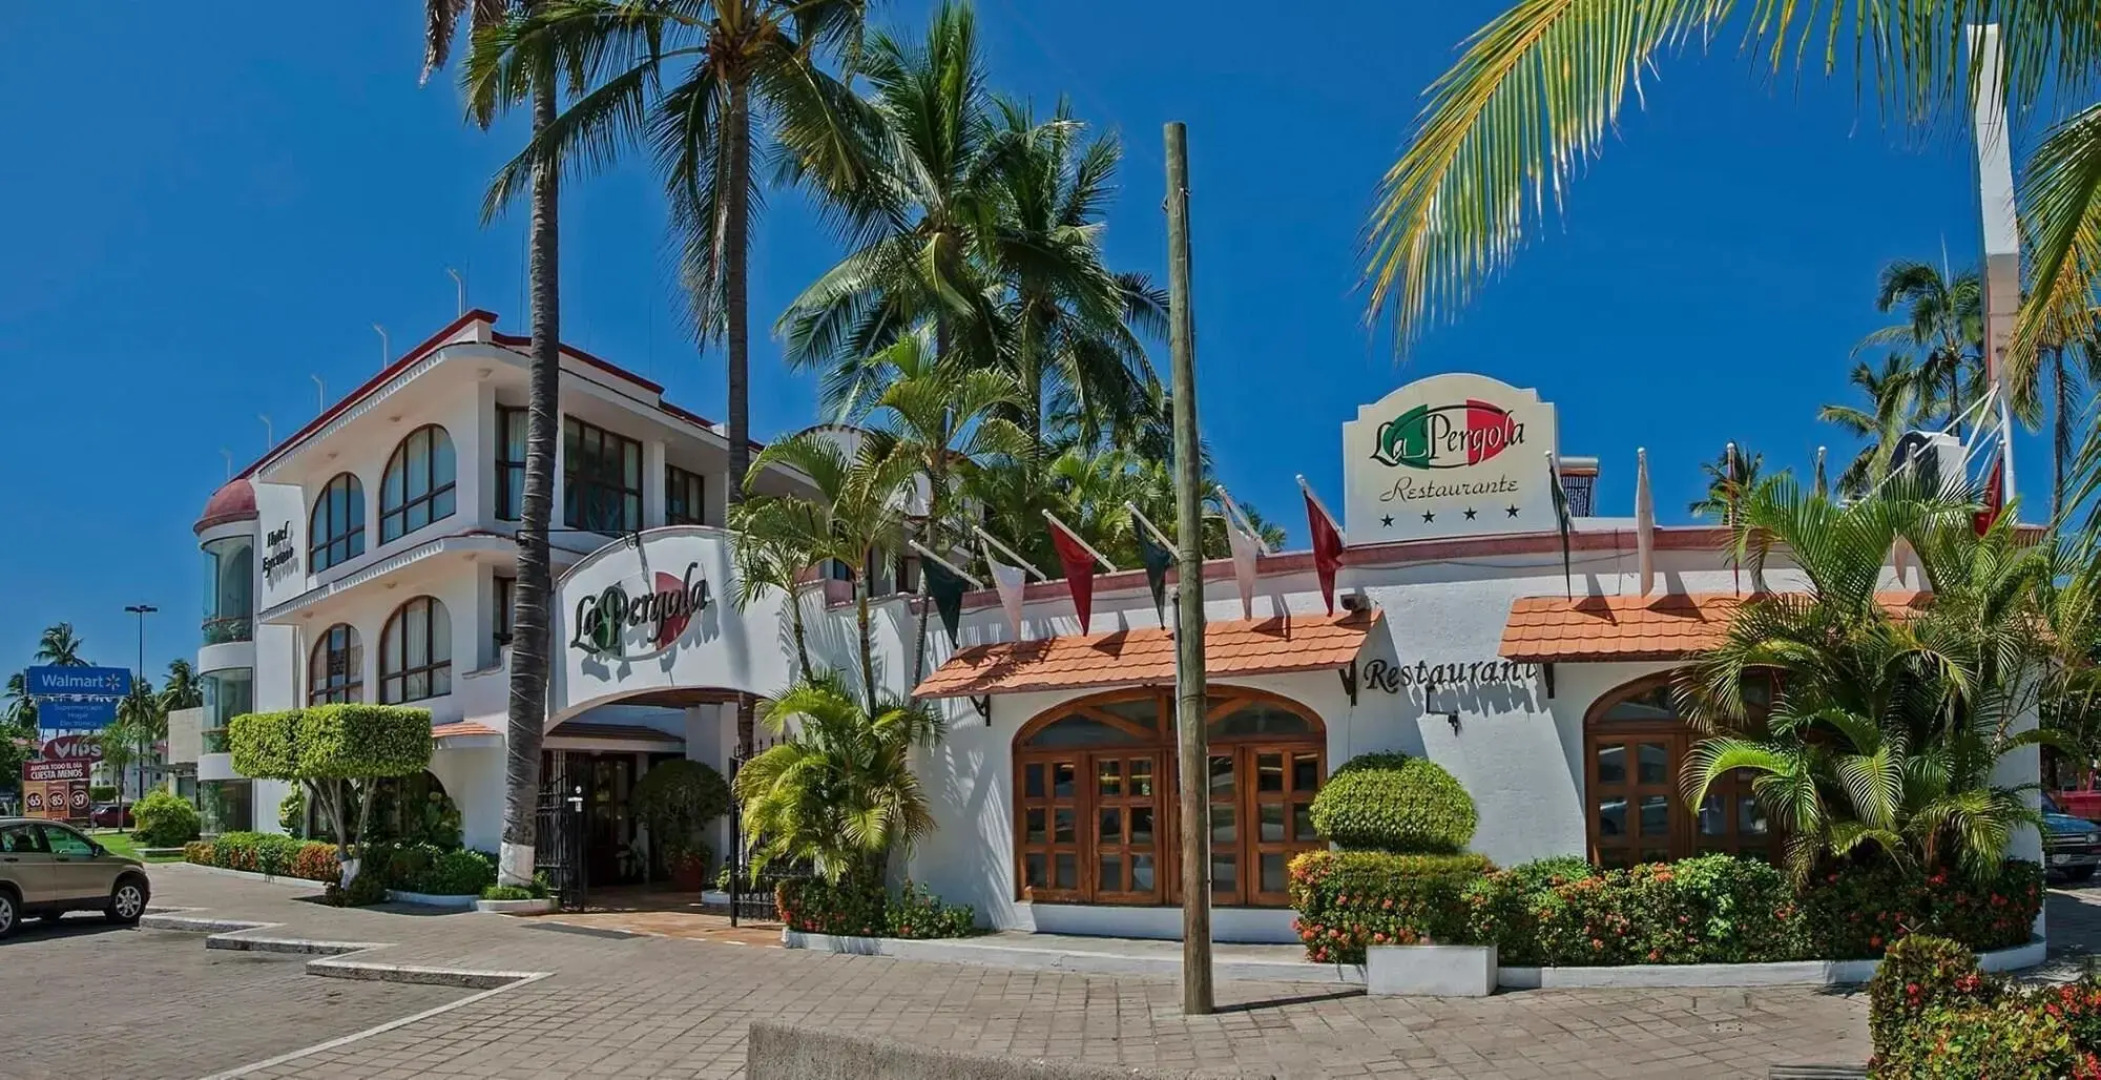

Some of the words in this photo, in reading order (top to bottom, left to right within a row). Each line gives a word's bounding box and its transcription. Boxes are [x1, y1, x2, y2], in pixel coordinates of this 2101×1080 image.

[1370, 421, 1410, 467] La
[1421, 410, 1526, 465] Pergola
[1379, 474, 1519, 502] Restaurante
[570, 595, 601, 654] La
[601, 561, 708, 648] Pergola
[42, 674, 104, 688] Walmart
[1363, 659, 1538, 694] Restaurant
[30, 770, 56, 780] CUESTA
[57, 769, 83, 778] MENOS
